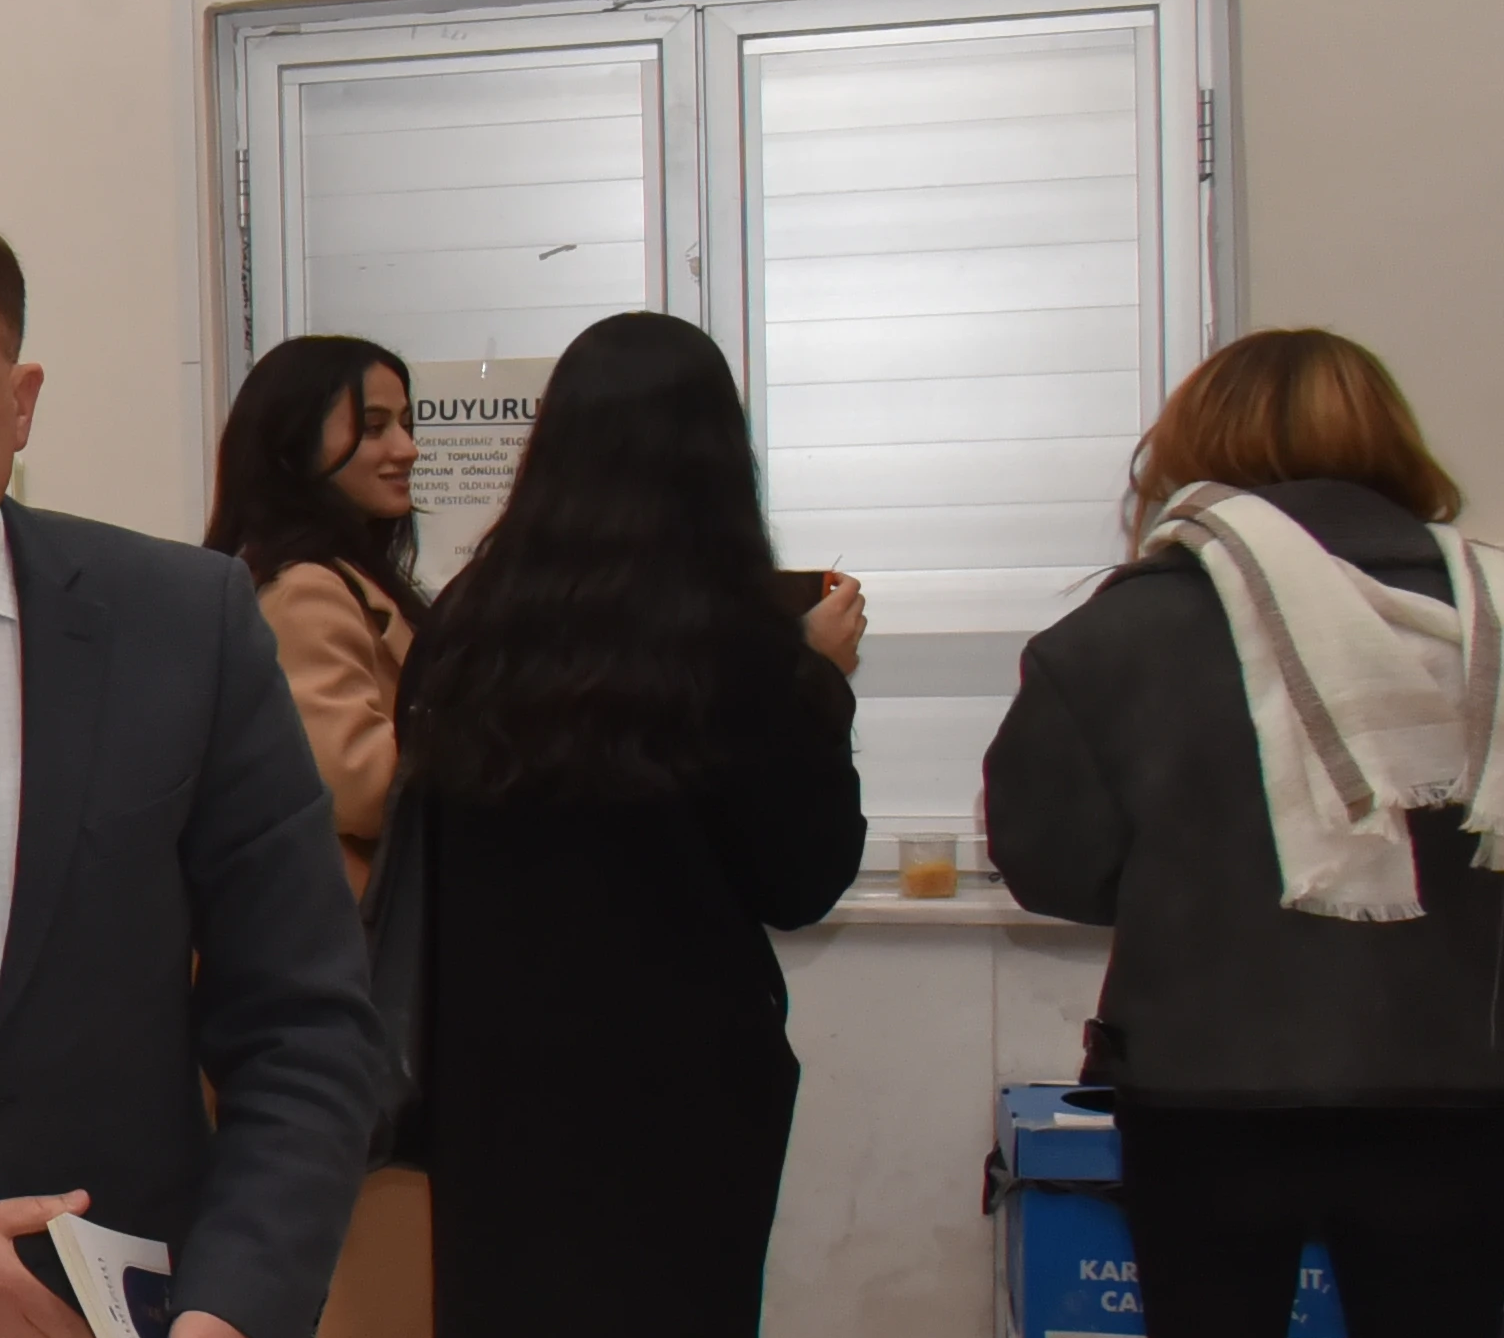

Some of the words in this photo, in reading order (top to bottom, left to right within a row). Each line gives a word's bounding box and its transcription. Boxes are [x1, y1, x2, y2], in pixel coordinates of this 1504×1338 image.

[417, 397, 541, 421] DUYURU
[447, 449, 508, 462] TOPLULUĞU
[1079, 1258, 1139, 1283] KAR
